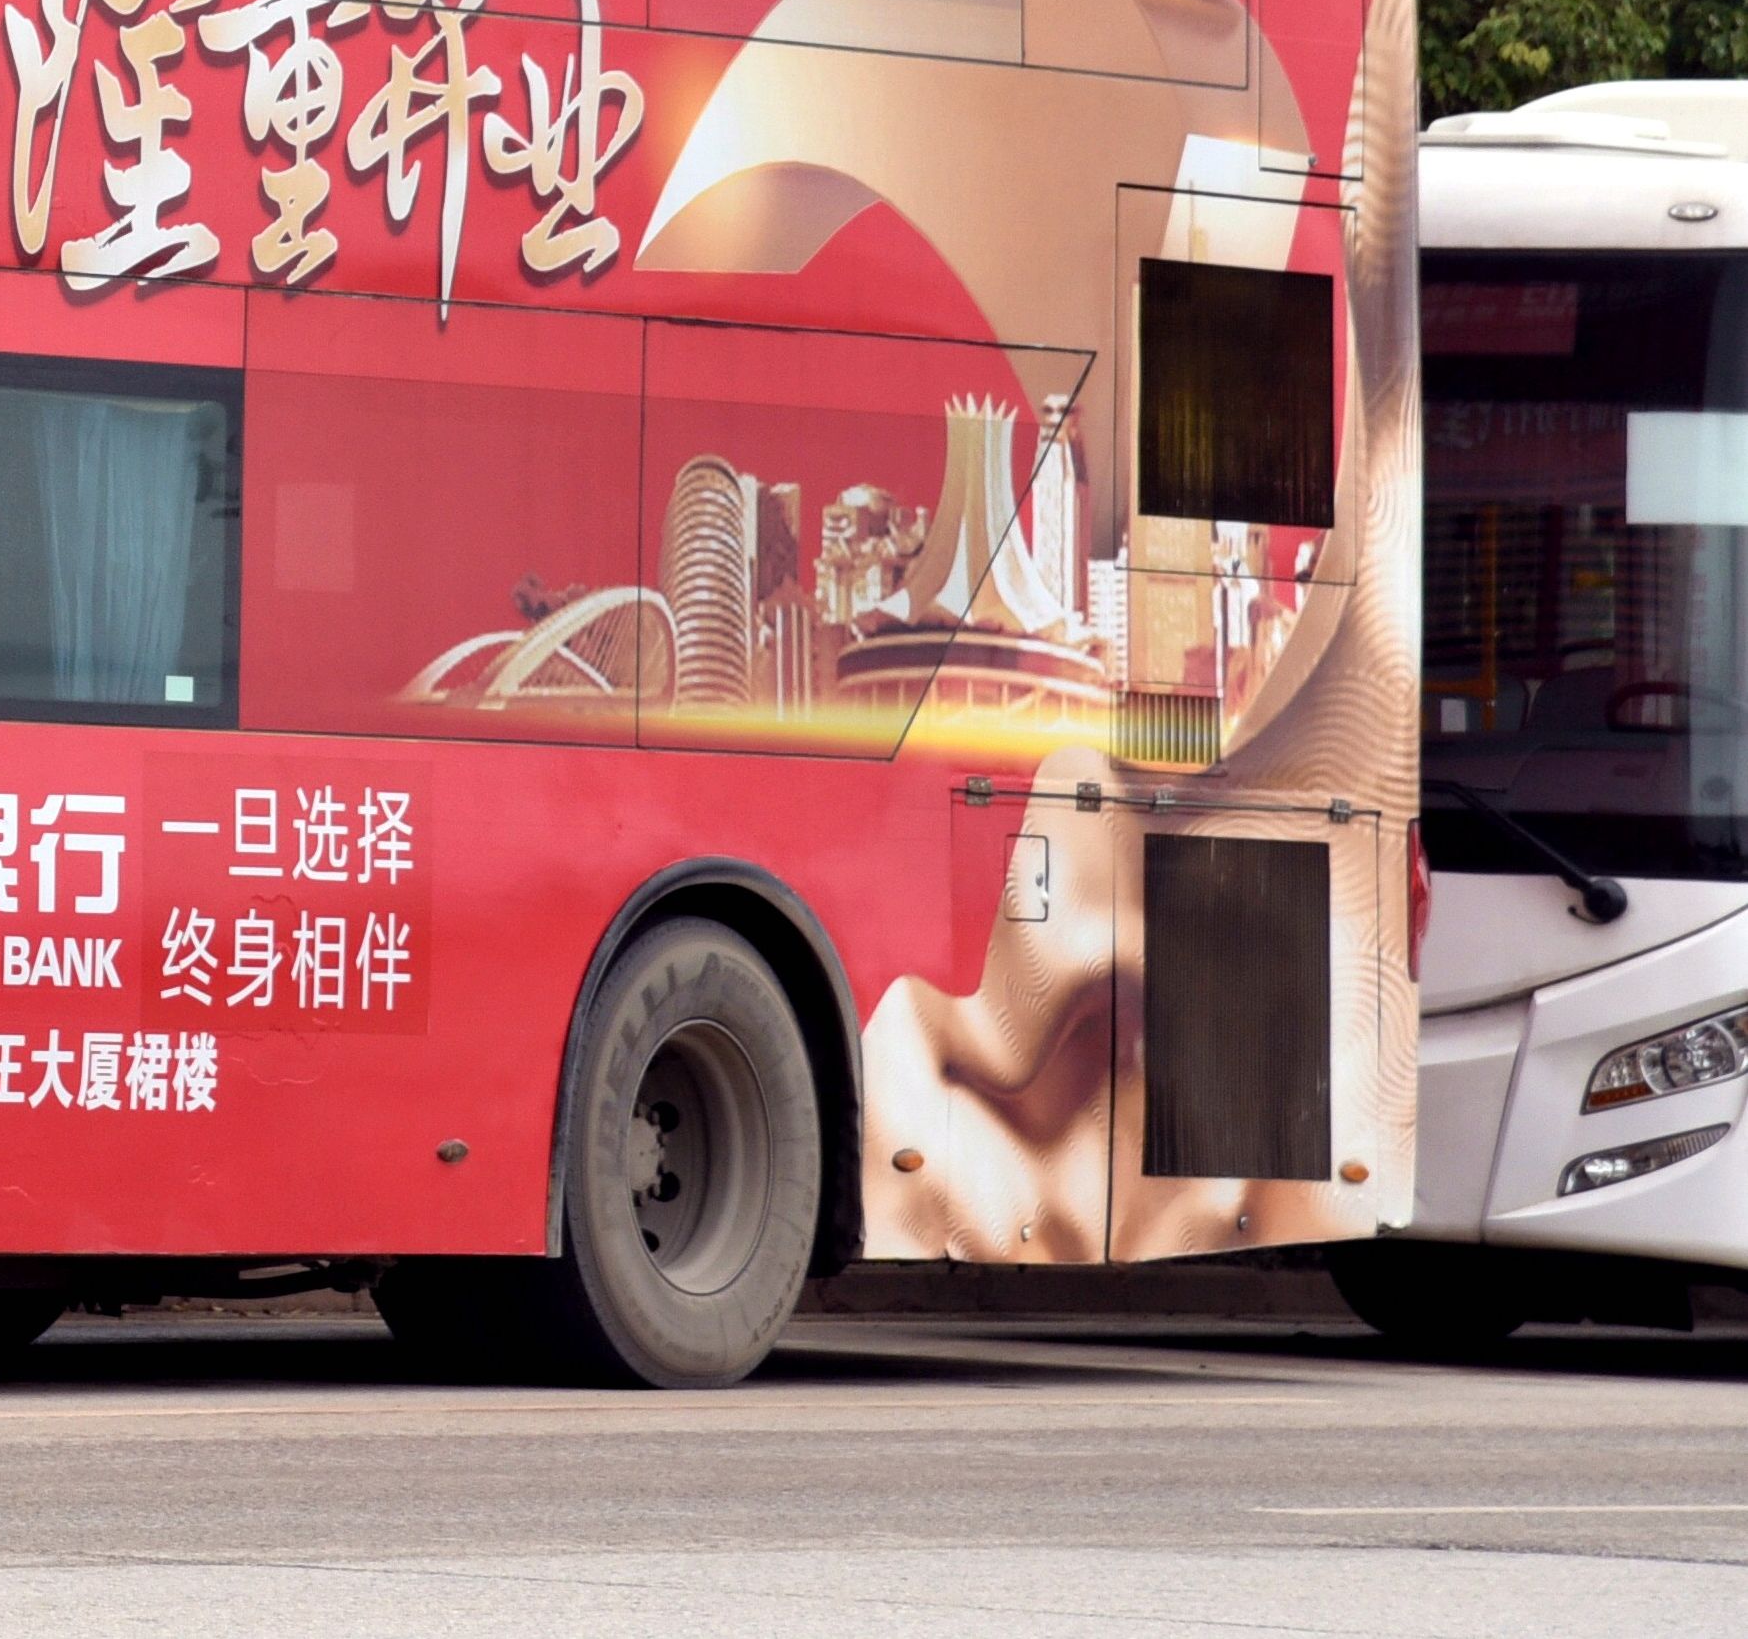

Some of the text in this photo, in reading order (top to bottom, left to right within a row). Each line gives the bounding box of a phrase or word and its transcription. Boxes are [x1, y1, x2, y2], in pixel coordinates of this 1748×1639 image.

[161, 784, 414, 885] 一旦选择
[3, 935, 122, 988] BANK
[160, 906, 411, 1011] 终身相伴
